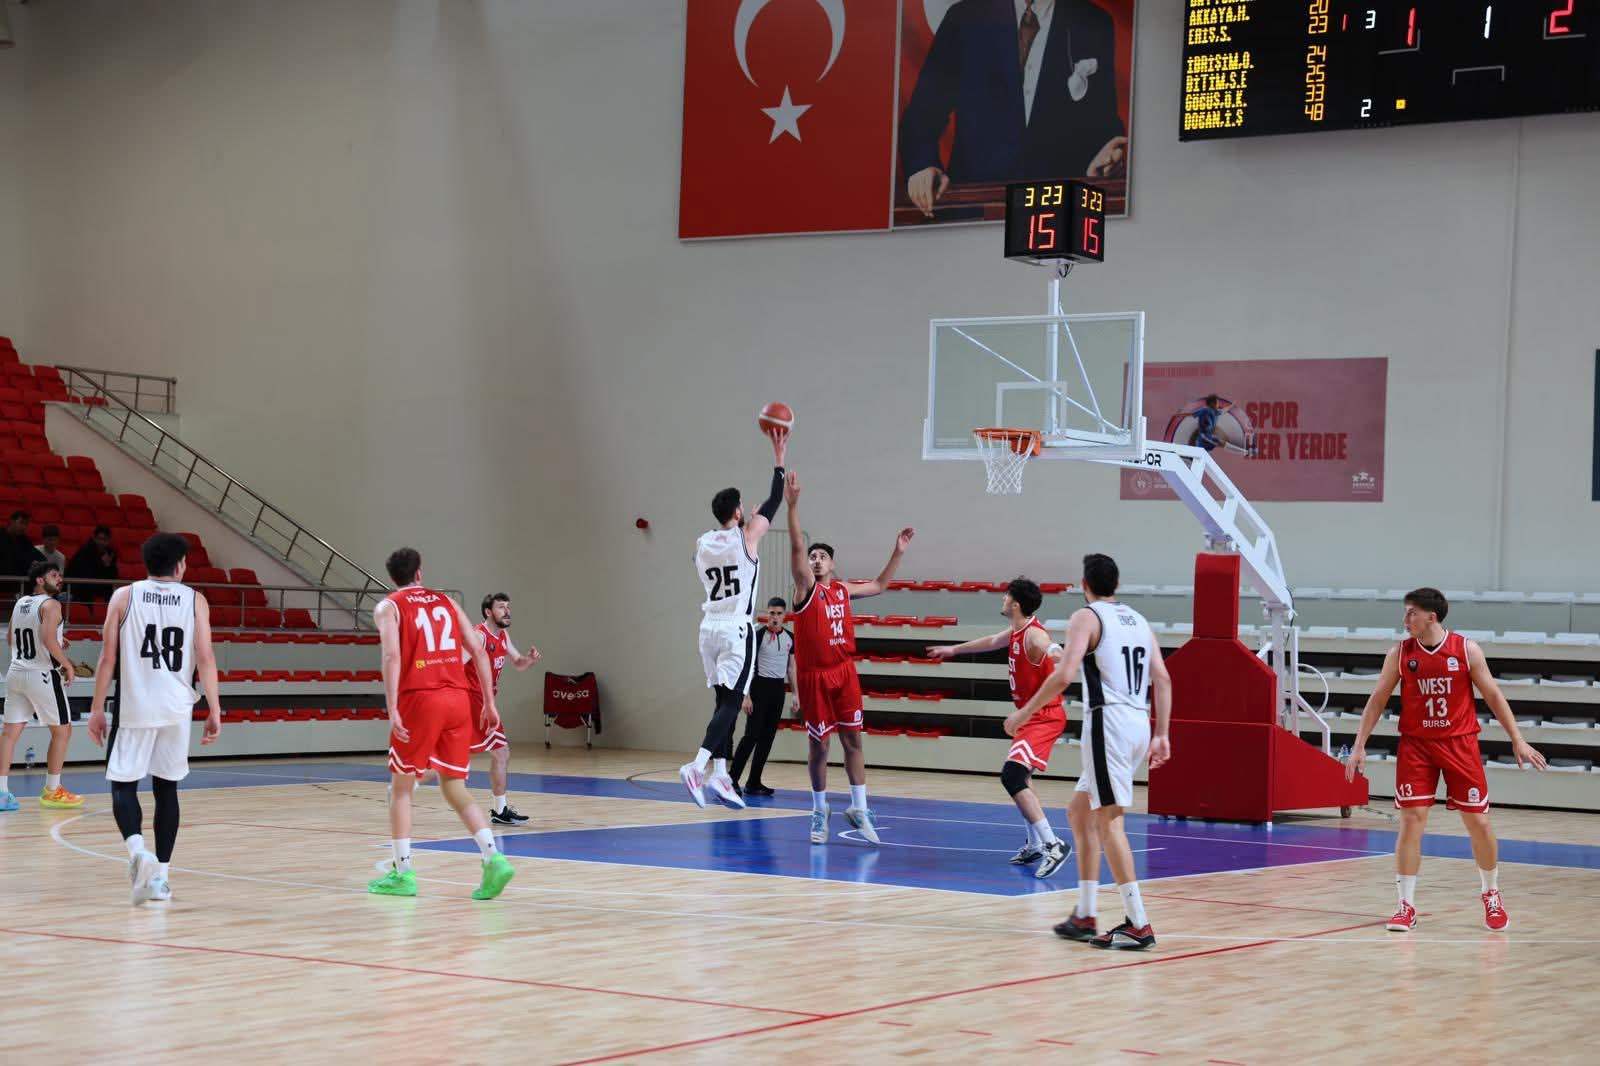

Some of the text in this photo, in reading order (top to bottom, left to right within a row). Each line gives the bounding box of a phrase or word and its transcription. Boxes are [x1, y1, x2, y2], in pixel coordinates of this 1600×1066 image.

[1308, 15, 1328, 34] 23
[1365, 10, 1376, 29] 3
[1549, 0, 1574, 33] 2
[1306, 45, 1327, 63] 24
[1306, 64, 1326, 83] 25
[1305, 83, 1325, 102] 33
[1304, 103, 1324, 121] 48
[1360, 98, 1372, 118] 2
[1024, 187, 1035, 207] 3
[1028, 213, 1056, 250] 15
[1083, 217, 1099, 255] 15
[1246, 401, 1299, 429] SPOR
[1286, 432, 1347, 460] YERDE
[705, 565, 741, 602] 25
[825, 604, 845, 619] WEST
[414, 606, 456, 653] 12
[830, 620, 843, 637] 14
[14, 628, 36, 660] 10
[140, 624, 184, 672] 48
[1121, 646, 1146, 696] 16
[1418, 677, 1453, 695] WEST
[1425, 697, 1448, 718] 13
[1422, 719, 1451, 728] BURSA
[1399, 783, 1413, 797] 13
